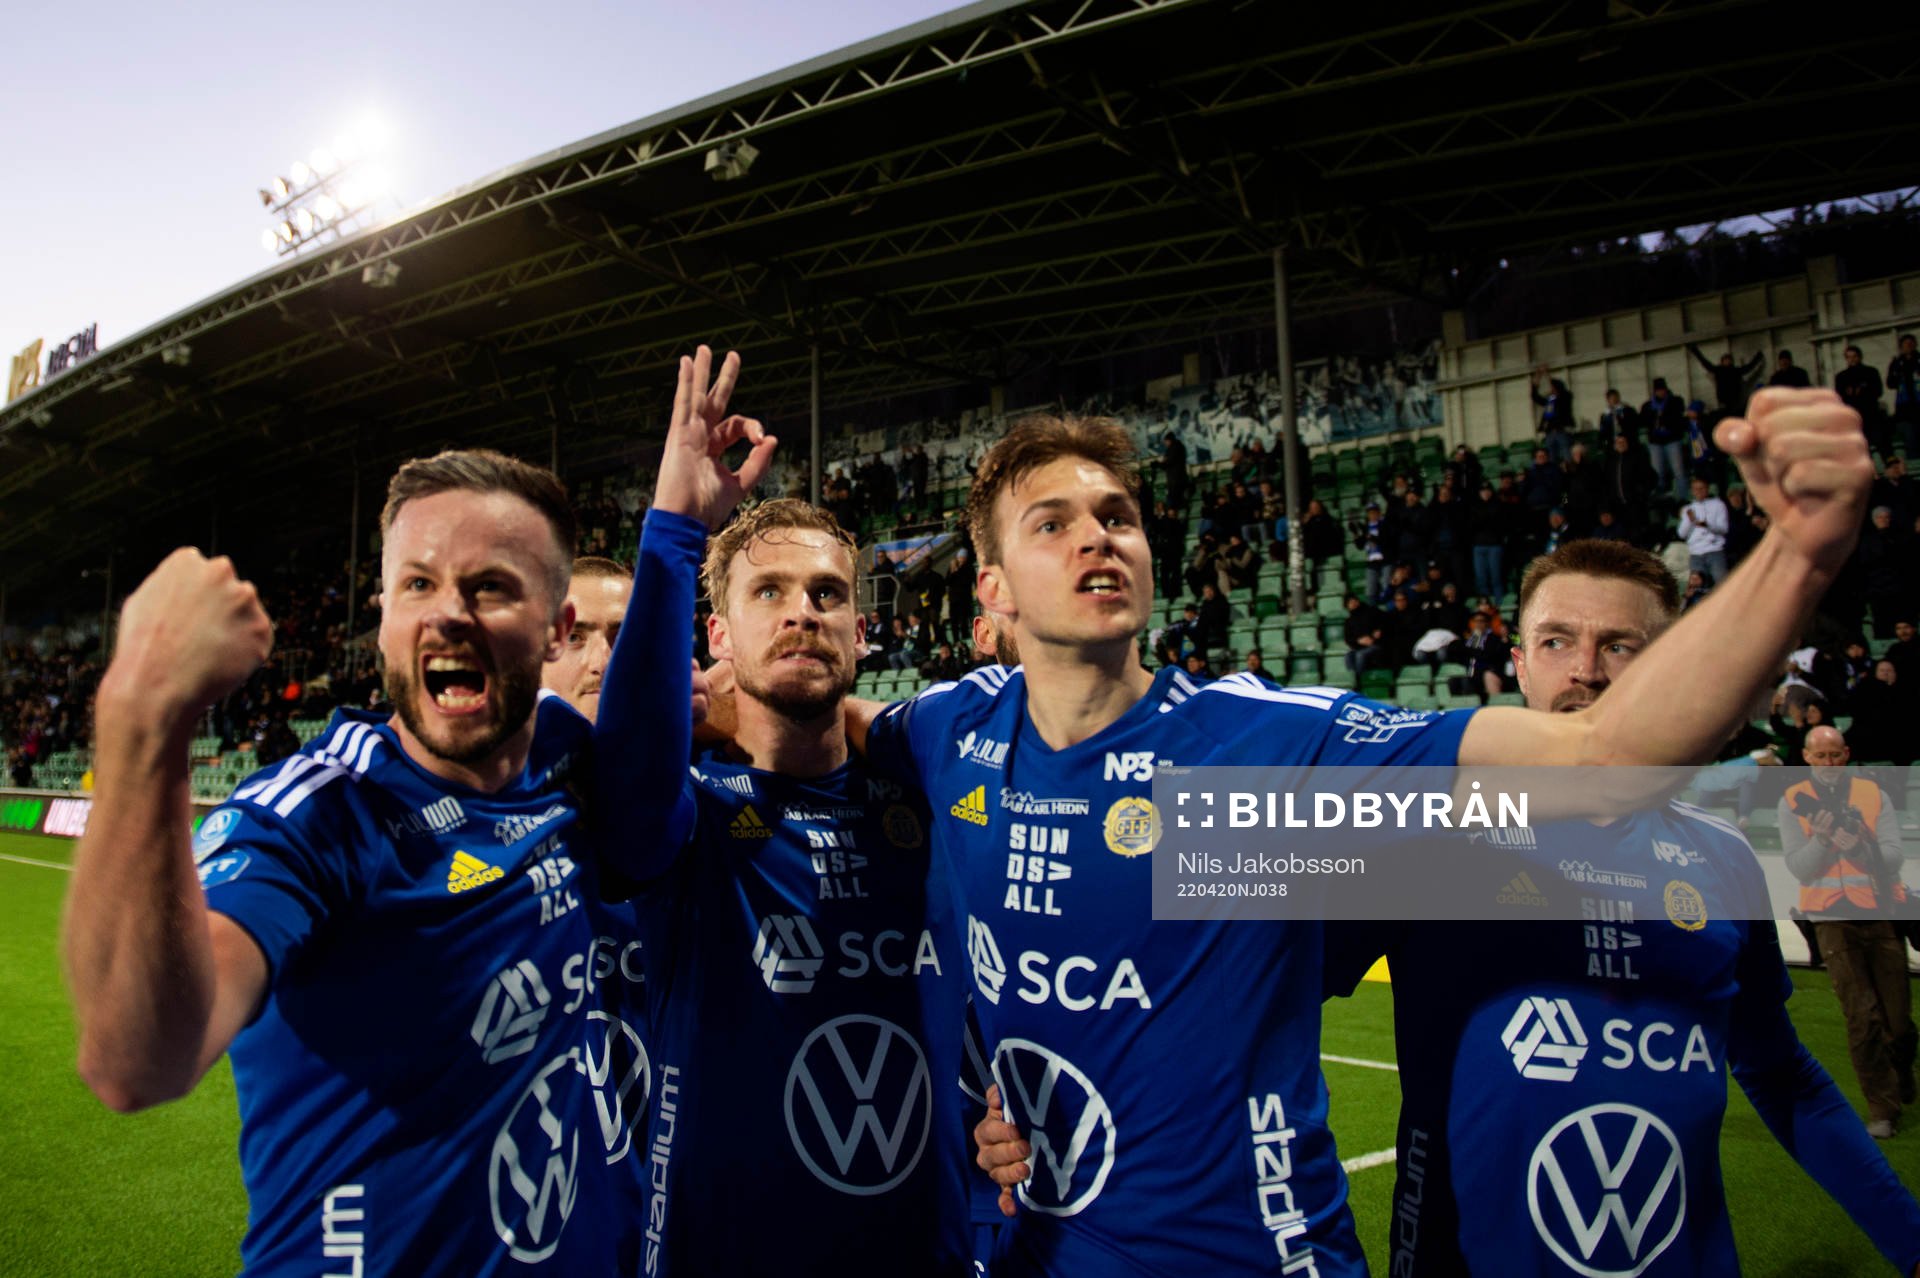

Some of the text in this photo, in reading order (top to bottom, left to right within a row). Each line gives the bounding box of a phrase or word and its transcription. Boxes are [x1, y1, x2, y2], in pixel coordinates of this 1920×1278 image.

[1103, 752, 1155, 782] NP3
[1052, 803, 1089, 815] HEDIN
[1009, 823, 1069, 855] SUN
[818, 876, 871, 901] ALL
[1615, 873, 1648, 889] HEDIN
[1004, 883, 1063, 916] ALL
[1581, 897, 1635, 924] SUN
[837, 929, 943, 978] SCA
[1587, 953, 1640, 980] ALL
[1017, 951, 1152, 1011] SCA
[1601, 1017, 1717, 1073] SCA
[645, 1064, 680, 1278] stadium
